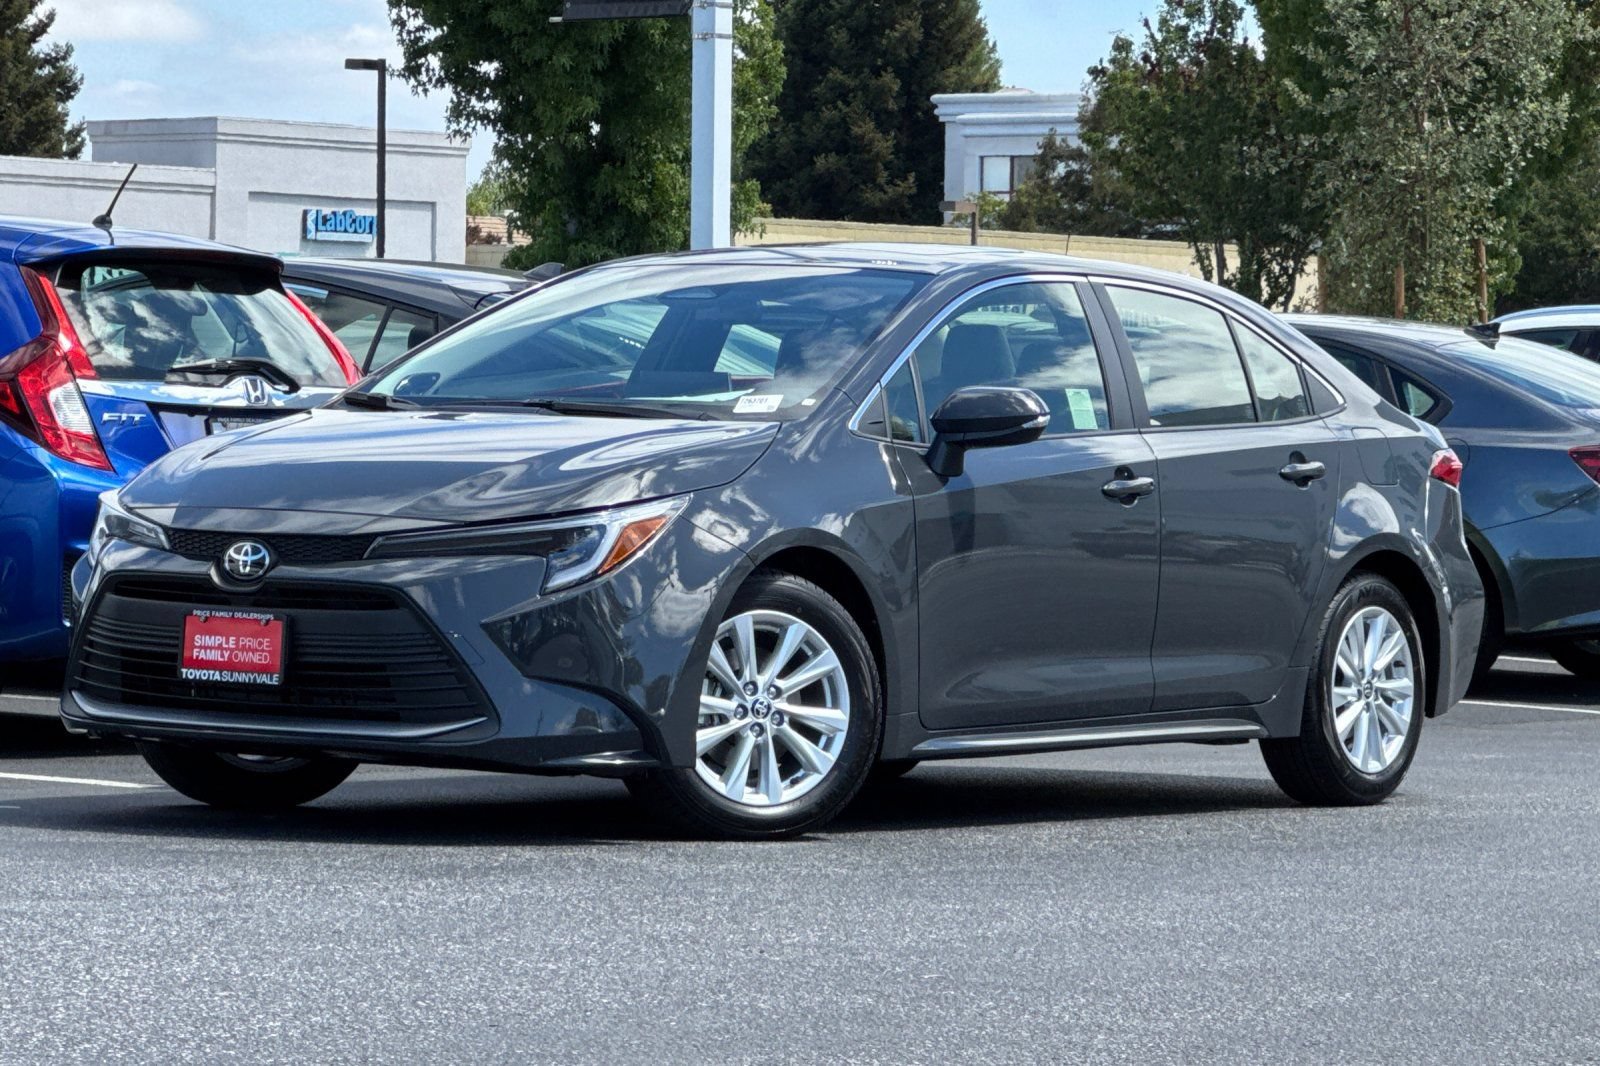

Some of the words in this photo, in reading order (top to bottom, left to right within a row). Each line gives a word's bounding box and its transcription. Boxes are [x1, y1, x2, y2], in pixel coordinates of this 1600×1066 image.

[101, 412, 146, 424] FIT
[193, 609, 210, 617] PRICE
[234, 612, 274, 620] DEALERSHIPS
[194, 635, 236, 648] SIMPLE
[239, 637, 272, 650] PRICE.
[193, 648, 230, 661] FAMILY
[232, 650, 272, 664] OWNED.
